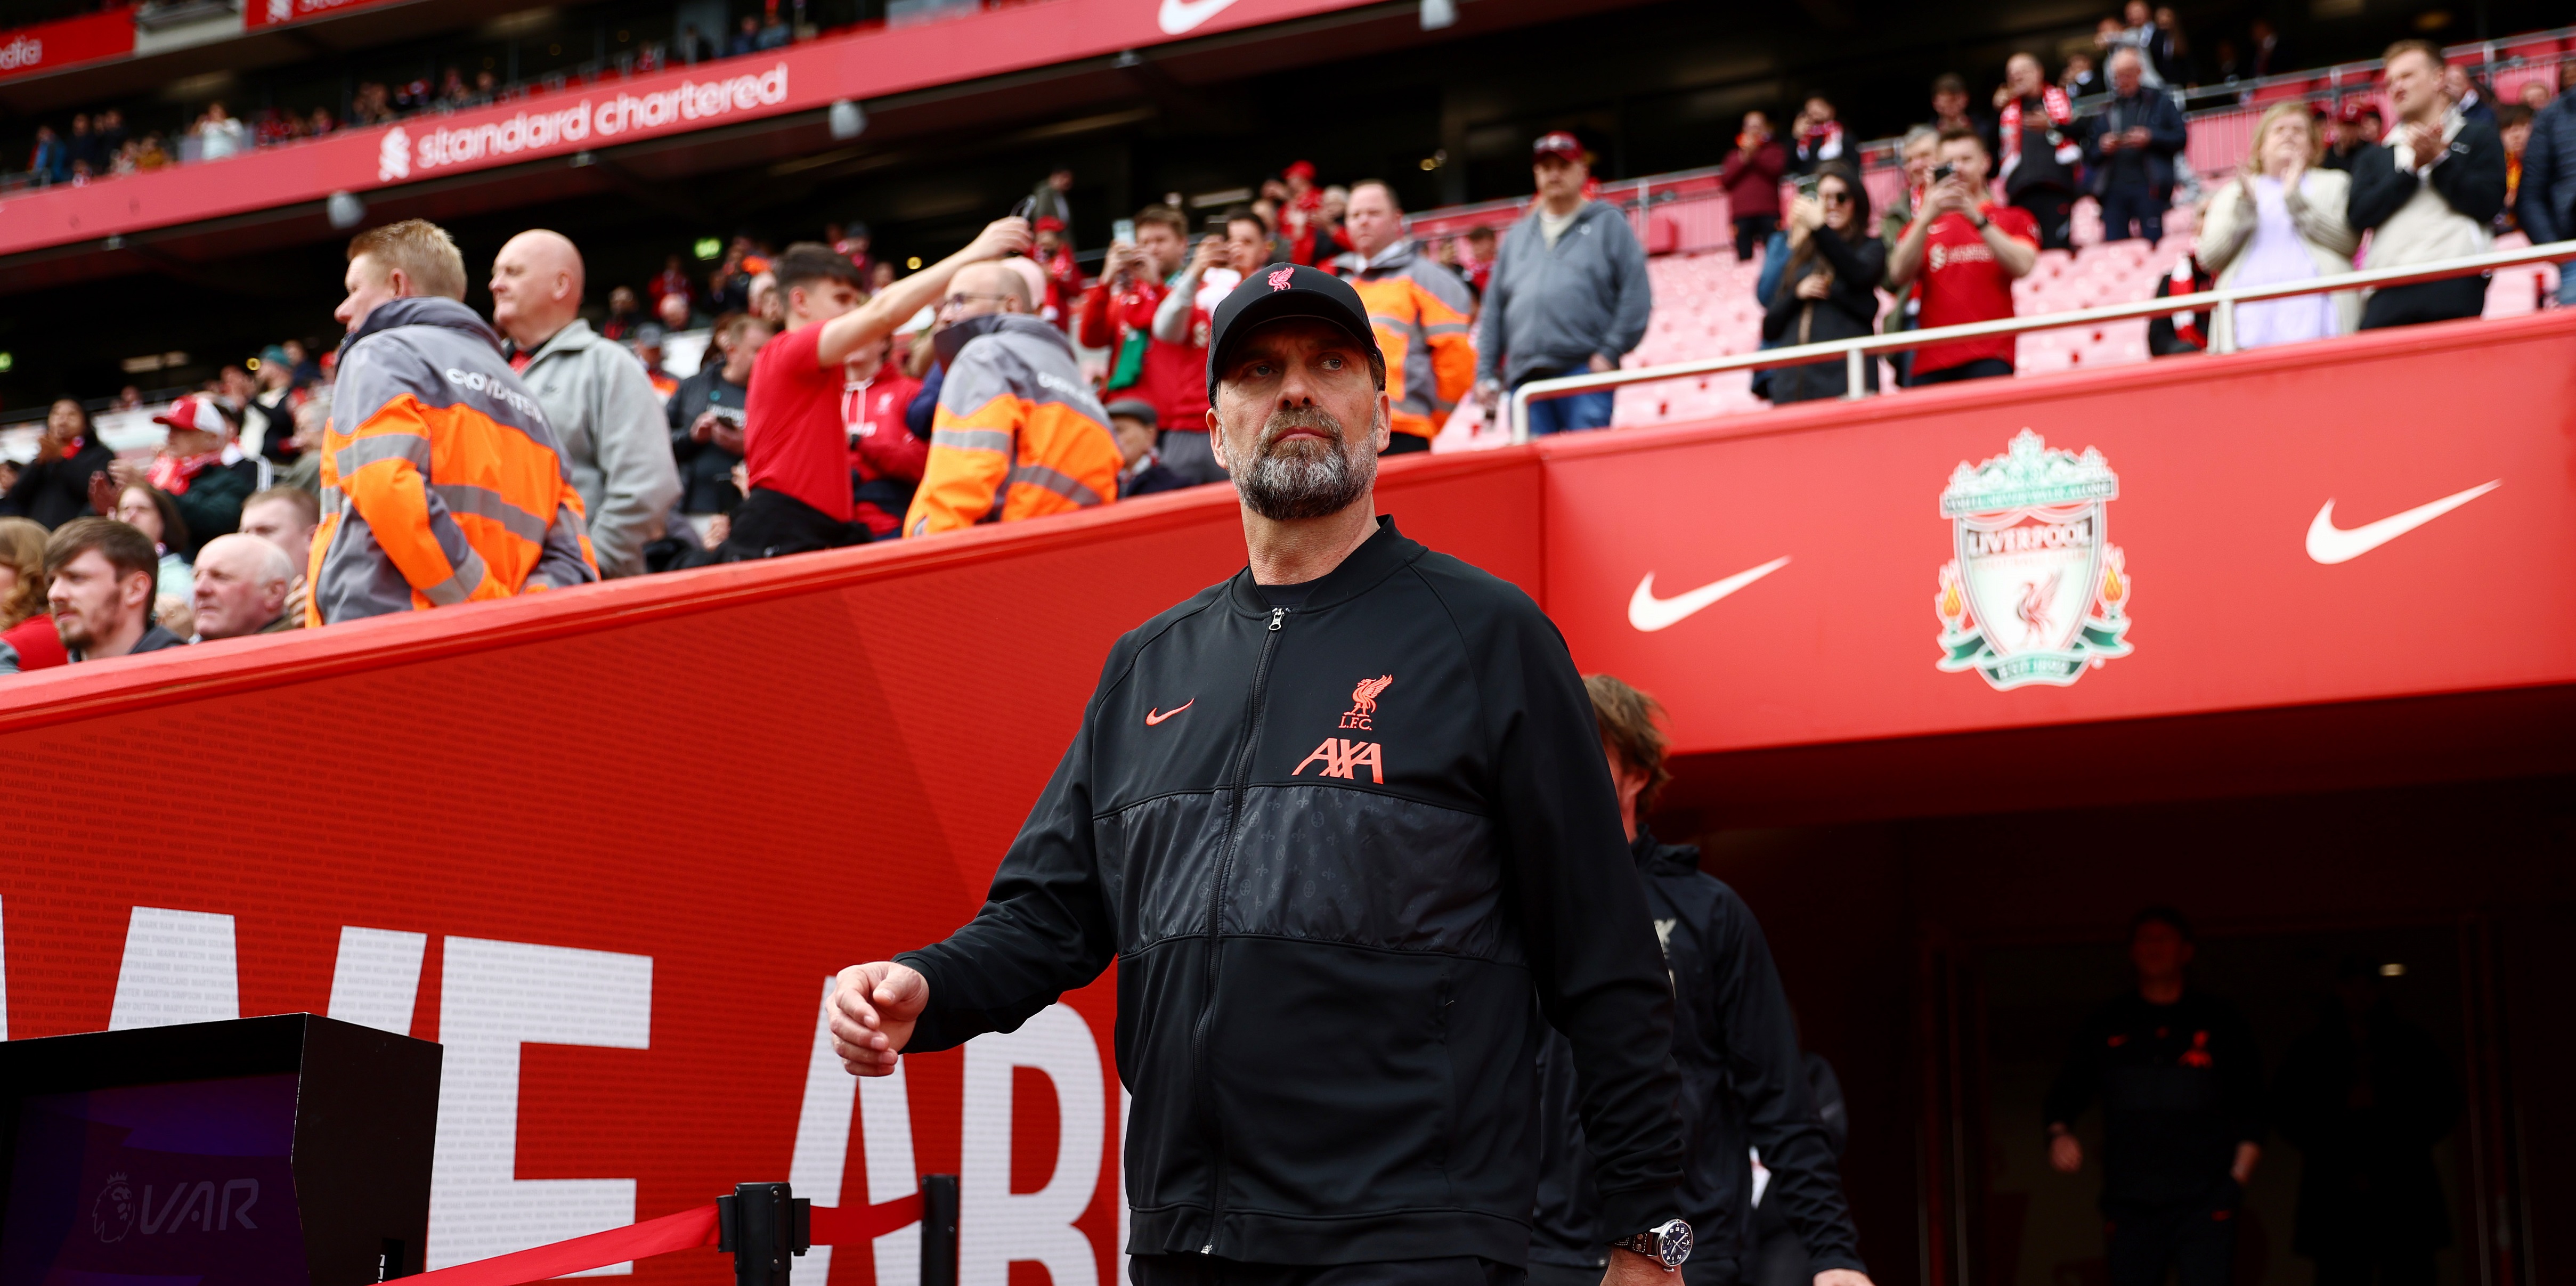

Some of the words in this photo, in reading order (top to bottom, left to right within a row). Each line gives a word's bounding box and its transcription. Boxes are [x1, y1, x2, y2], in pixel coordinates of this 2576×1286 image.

[417, 99, 592, 169] standard
[594, 61, 789, 137] chartered
[1968, 519, 2092, 556] LIVERPOOL
[1338, 716, 1372, 730] L.F.C.
[1291, 737, 1384, 785] AXA
[5, 821, 27, 832] MARK
[14, 967, 44, 977] MARTIN
[787, 975, 1133, 1286] AR
[140, 1177, 259, 1235] VAR
